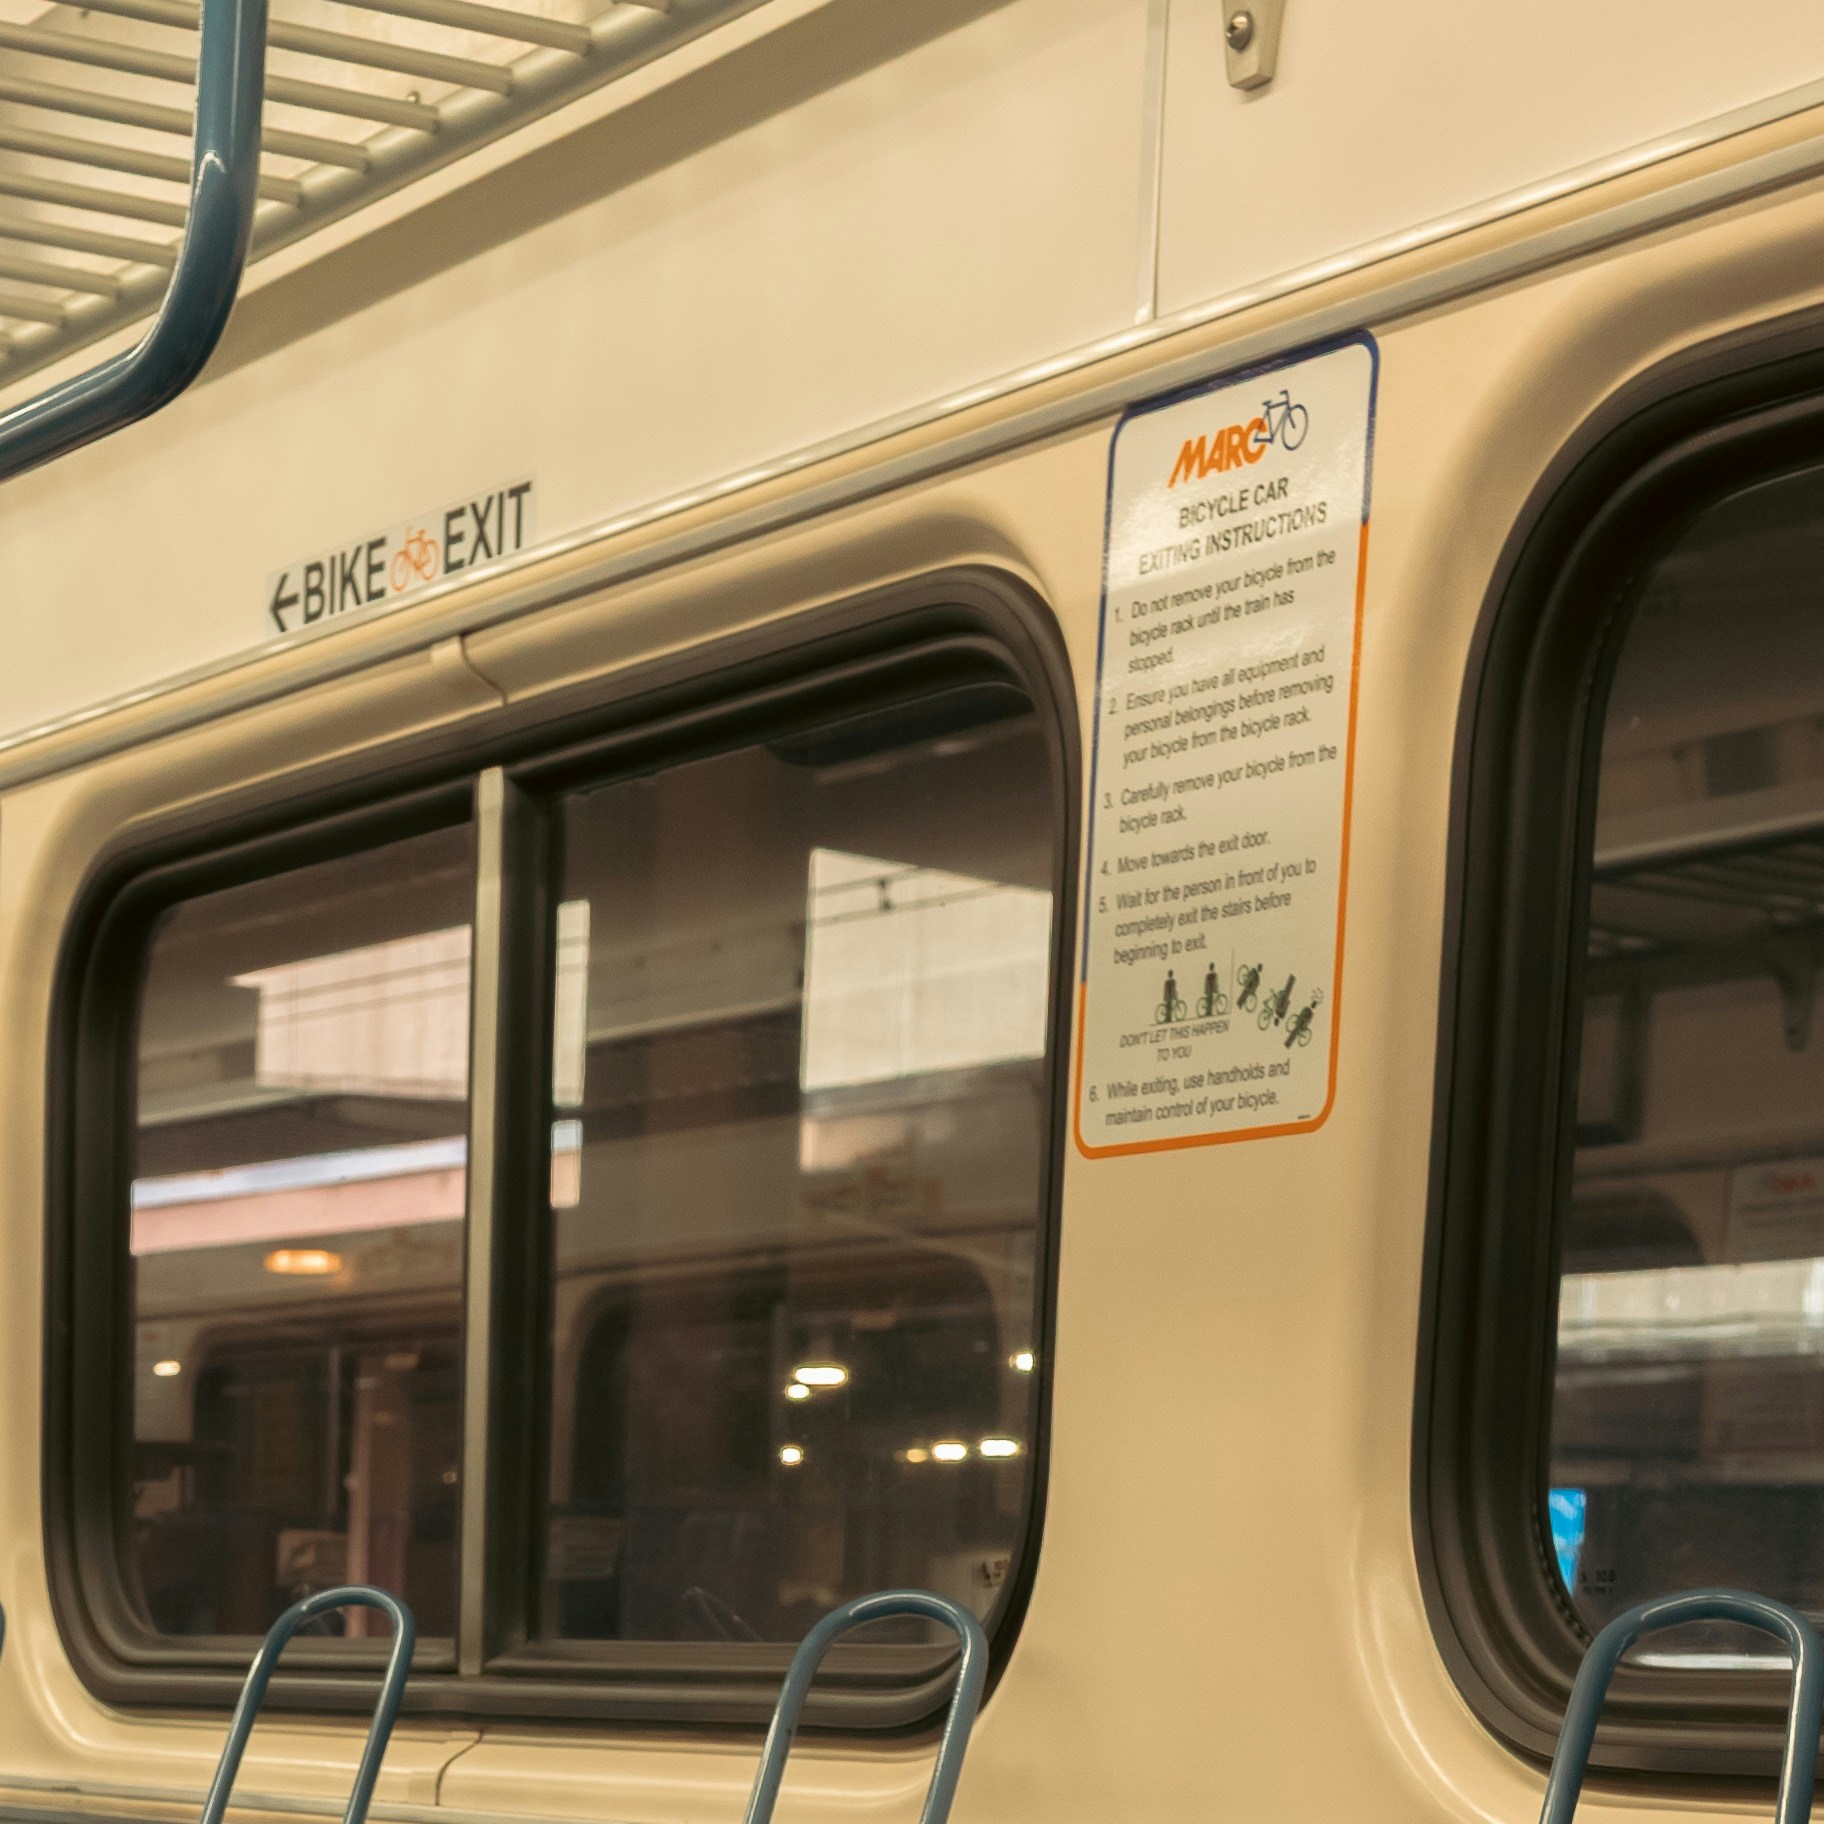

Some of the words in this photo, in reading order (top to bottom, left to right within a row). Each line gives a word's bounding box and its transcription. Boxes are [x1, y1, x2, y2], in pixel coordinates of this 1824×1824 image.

[1167, 416, 1267, 489] MARC
[1178, 488, 1249, 529] BICYCLE
[1254, 477, 1289, 506] CAR
[303, 536, 387, 624] BIKE
[443, 480, 533, 575] EXIT
[1139, 538, 1202, 576] EXITING
[1205, 501, 1328, 556] INSTRUCTIONS
[1131, 600, 1147, 619] Do
[1149, 595, 1168, 613] not
[1170, 584, 1212, 607] remove
[1216, 577, 1242, 602] your
[1244, 563, 1283, 593] bicycle
[1287, 557, 1314, 576] from
[1316, 549, 1336, 567] the
[1129, 622, 1168, 647] bicycle
[1170, 615, 1196, 635] rack
[1197, 609, 1220, 628] until
[1223, 601, 1241, 619] the
[1244, 595, 1270, 615] train
[1273, 588, 1294, 607] has
[1126, 689, 1165, 711] Ensure
[1168, 684, 1189, 704] you
[1191, 675, 1219, 694] have
[1222, 668, 1235, 687] all
[1238, 653, 1299, 683] equipment
[1301, 645, 1324, 666] and
[1124, 711, 1173, 741] personal
[1174, 698, 1236, 723] belongings
[1238, 688, 1275, 710] before
[1278, 674, 1333, 700] removing
[1123, 747, 1148, 769] your
[1150, 736, 1189, 759] bicycle
[1191, 729, 1217, 749] from
[1220, 724, 1238, 742] the
[1240, 714, 1280, 738] bicycle
[1121, 781, 1170, 806] Carefully
[1172, 772, 1214, 794] remove
[1218, 766, 1242, 789] your
[1244, 755, 1285, 780] bicycle
[1288, 750, 1315, 768] from
[1318, 743, 1337, 762] the
[1119, 812, 1158, 835] bicycle
[1118, 855, 1148, 874] Move
[1151, 845, 1195, 868] towards
[1198, 840, 1216, 858] the
[1219, 834, 1239, 854] exit
[1241, 830, 1271, 850] door.
[1115, 892, 1142, 910] Wait
[1144, 888, 1160, 905] for
[1162, 885, 1180, 902] the
[1183, 878, 1222, 901] person
[1224, 872, 1235, 889] in
[1238, 868, 1264, 887] front
[1266, 862, 1279, 882] of
[1281, 863, 1302, 884] you
[1304, 857, 1317, 874] to
[1115, 912, 1175, 937] completely
[1177, 907, 1198, 927] exit
[1200, 904, 1219, 922] the
[1221, 898, 1252, 918] stairs
[1254, 891, 1292, 912] before
[1113, 941, 1168, 966] beginning
[1171, 938, 1182, 955] to
[1107, 1081, 1138, 1100] While
[1183, 1074, 1204, 1090] use
[1207, 1062, 1265, 1087] handholds
[1267, 1058, 1290, 1077] and
[1105, 1105, 1152, 1126] maintain
[1155, 1100, 1193, 1121] control
[1195, 1096, 1208, 1115] of
[1209, 1095, 1234, 1117] your
